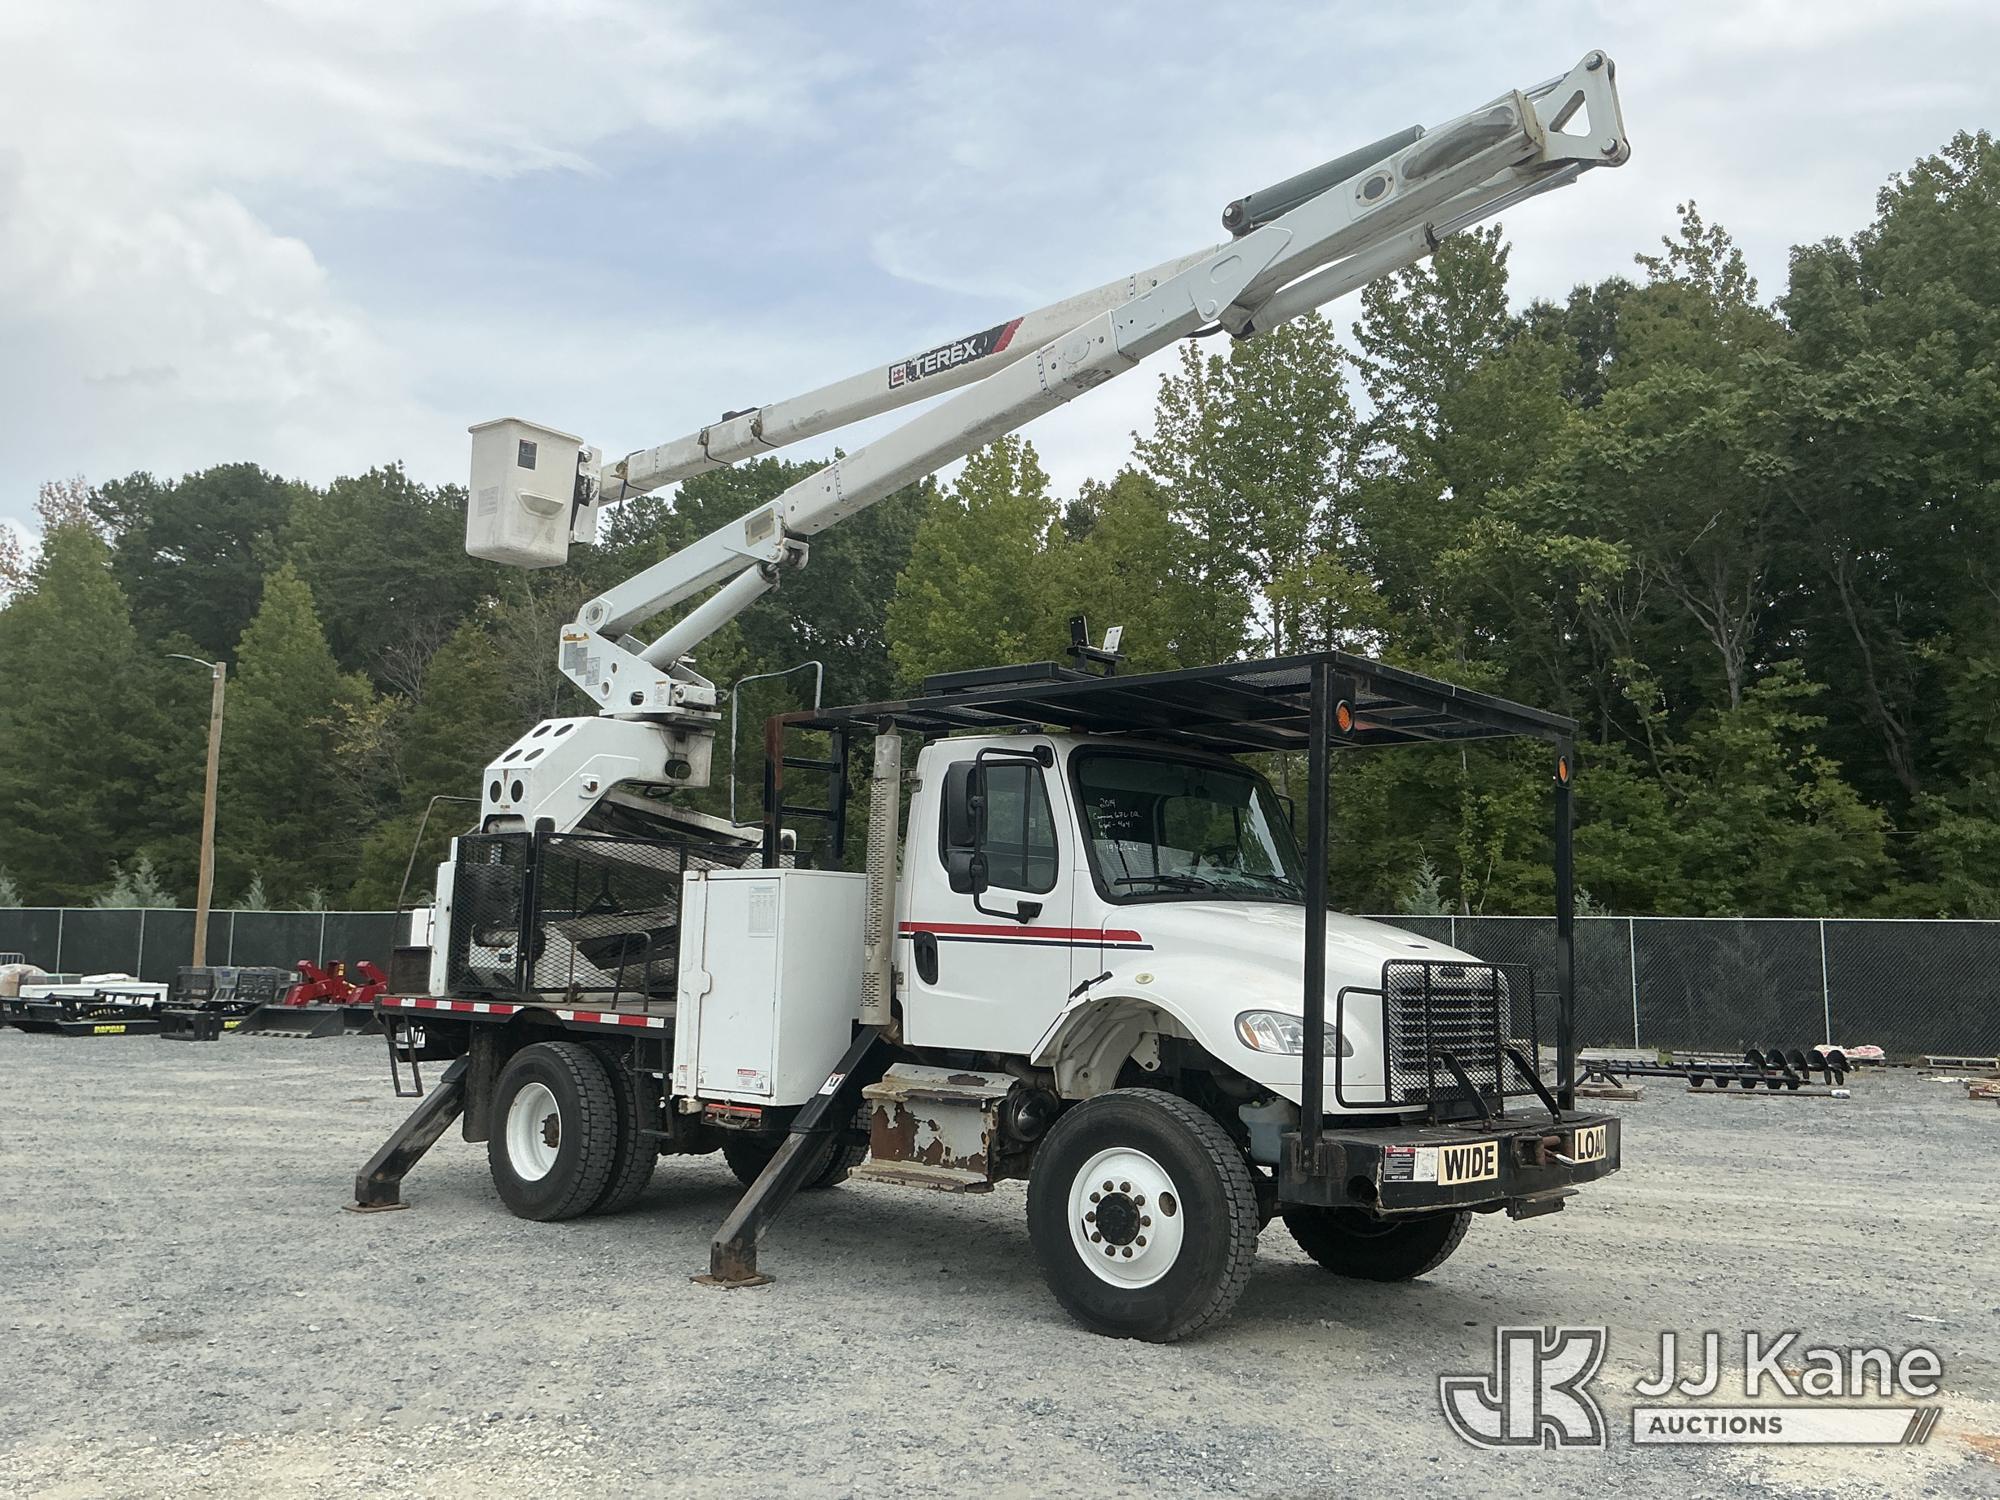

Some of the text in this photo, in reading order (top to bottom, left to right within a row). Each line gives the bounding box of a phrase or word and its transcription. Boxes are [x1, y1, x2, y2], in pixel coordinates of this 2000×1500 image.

[915, 338, 977, 376] TEREX
[1444, 1144, 1495, 1181] WIDE
[1577, 1128, 1605, 1160] LOAD
